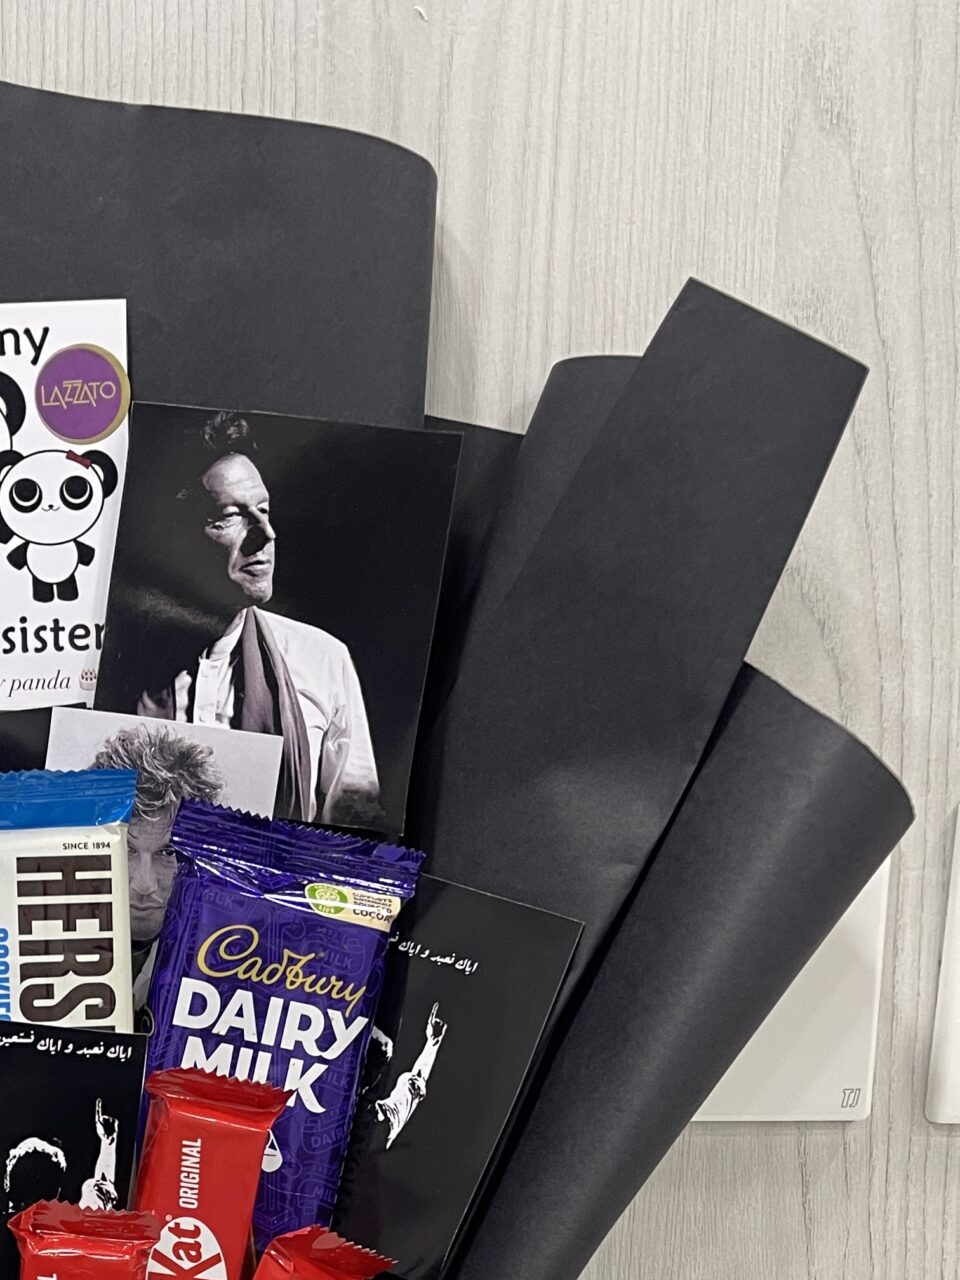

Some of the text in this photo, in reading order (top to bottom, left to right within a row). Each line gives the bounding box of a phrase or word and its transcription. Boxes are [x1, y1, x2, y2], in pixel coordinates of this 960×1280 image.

[41, 379, 116, 411] LAZZATO
[1, 615, 107, 656] sister
[6, 668, 71, 697] panda
[62, 840, 111, 851] SINCE 1894
[16, 854, 117, 1033] HERS
[196, 924, 367, 1017] Cadbury
[172, 976, 368, 1060] DAIRY
[36, 1038, 62, 1055] اياك
[64, 1043, 74, 1053] و
[76, 1041, 104, 1058] نعبد
[106, 1045, 132, 1062] اياك
[179, 1138, 202, 1210] ORIGINAL
